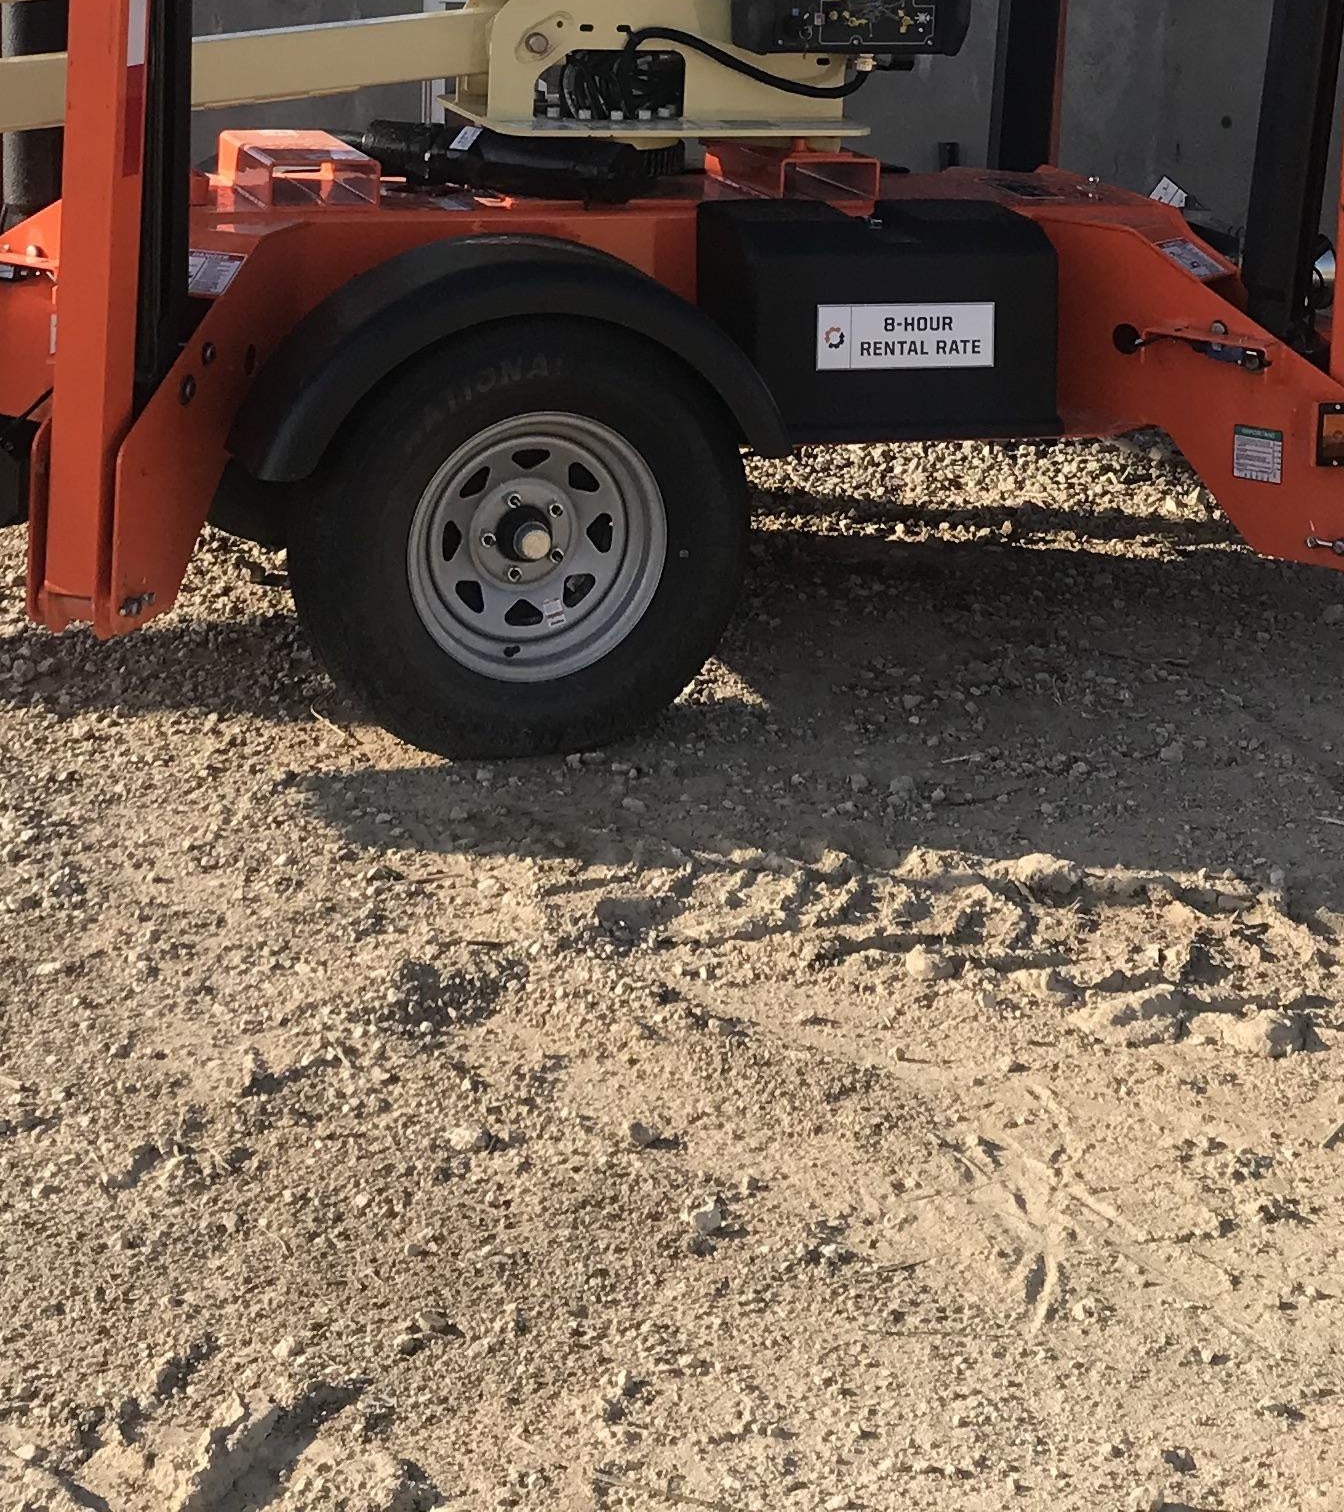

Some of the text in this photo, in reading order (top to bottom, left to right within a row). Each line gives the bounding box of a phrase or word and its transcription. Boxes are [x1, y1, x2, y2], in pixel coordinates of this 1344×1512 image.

[883, 316, 953, 332] 8-HOUR
[860, 339, 981, 357] RENTAL RATE
